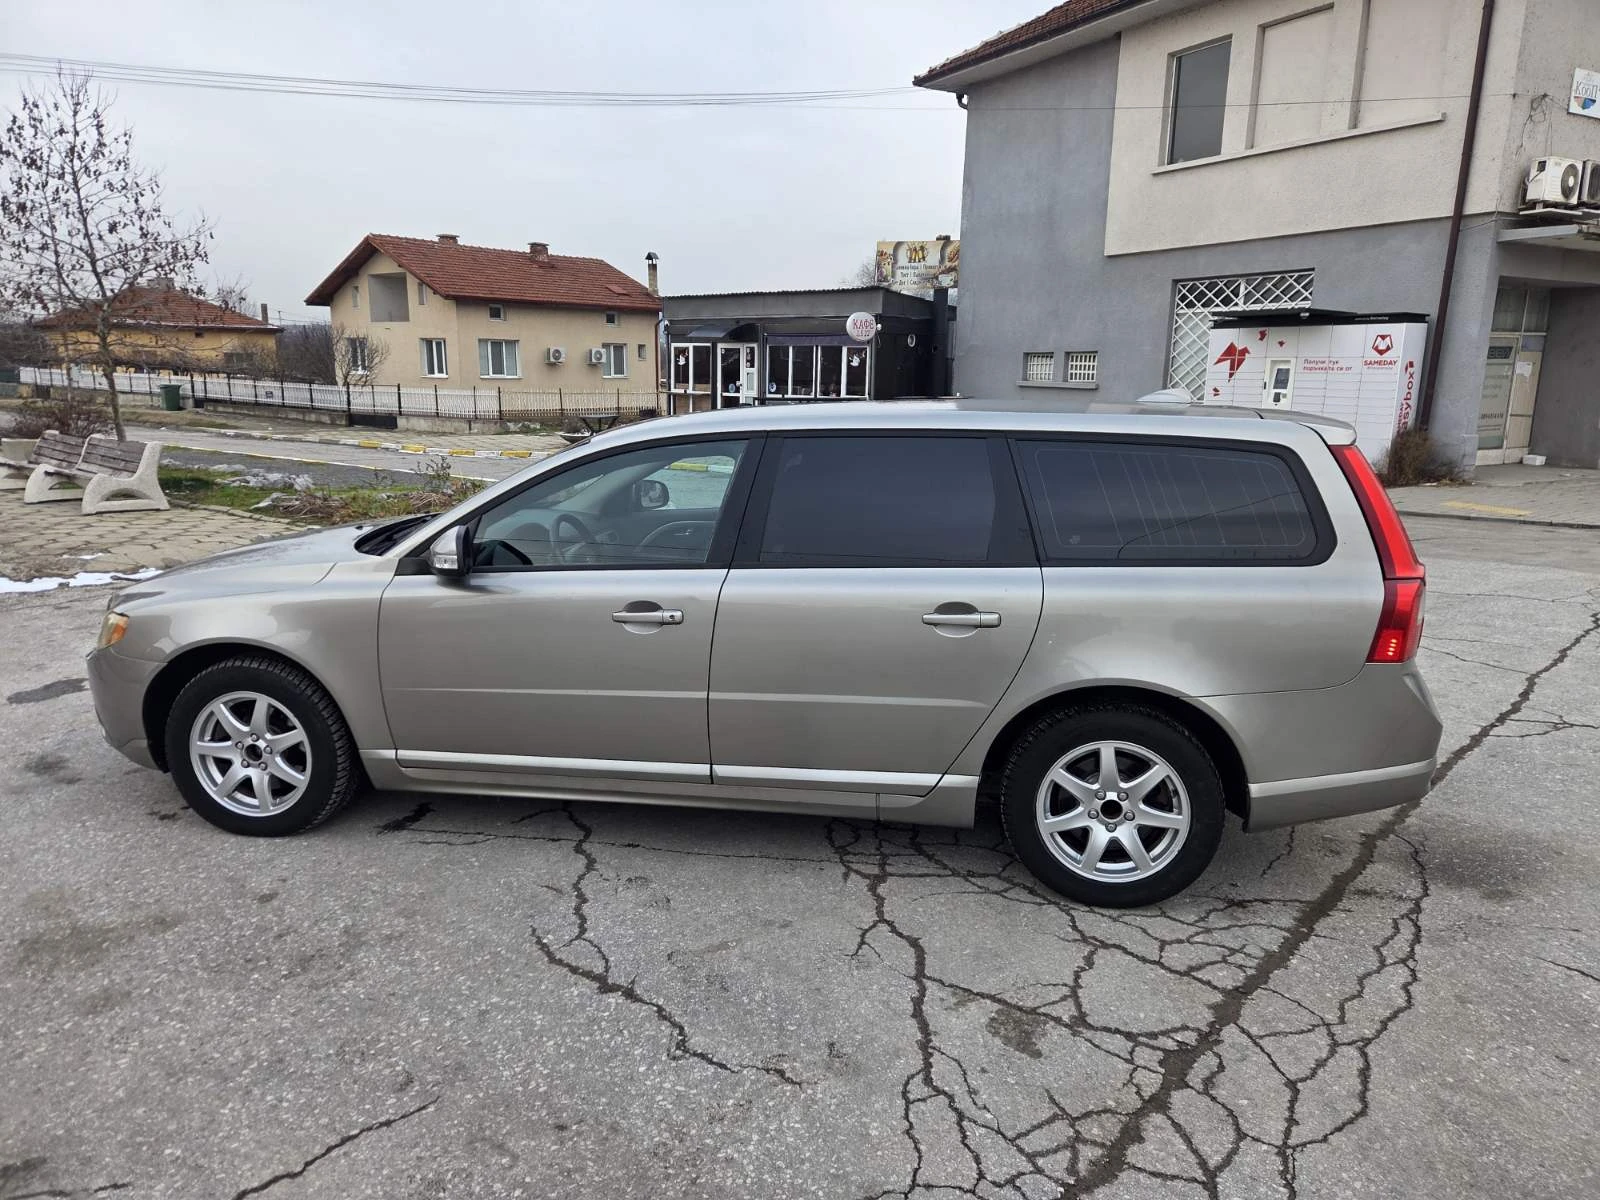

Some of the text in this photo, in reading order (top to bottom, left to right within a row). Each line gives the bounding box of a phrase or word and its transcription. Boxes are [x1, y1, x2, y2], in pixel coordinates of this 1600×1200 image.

[853, 318, 875, 330] КАФЕ
[1363, 359, 1398, 367] SAMEDAY
[1401, 370, 1415, 431] asybox
